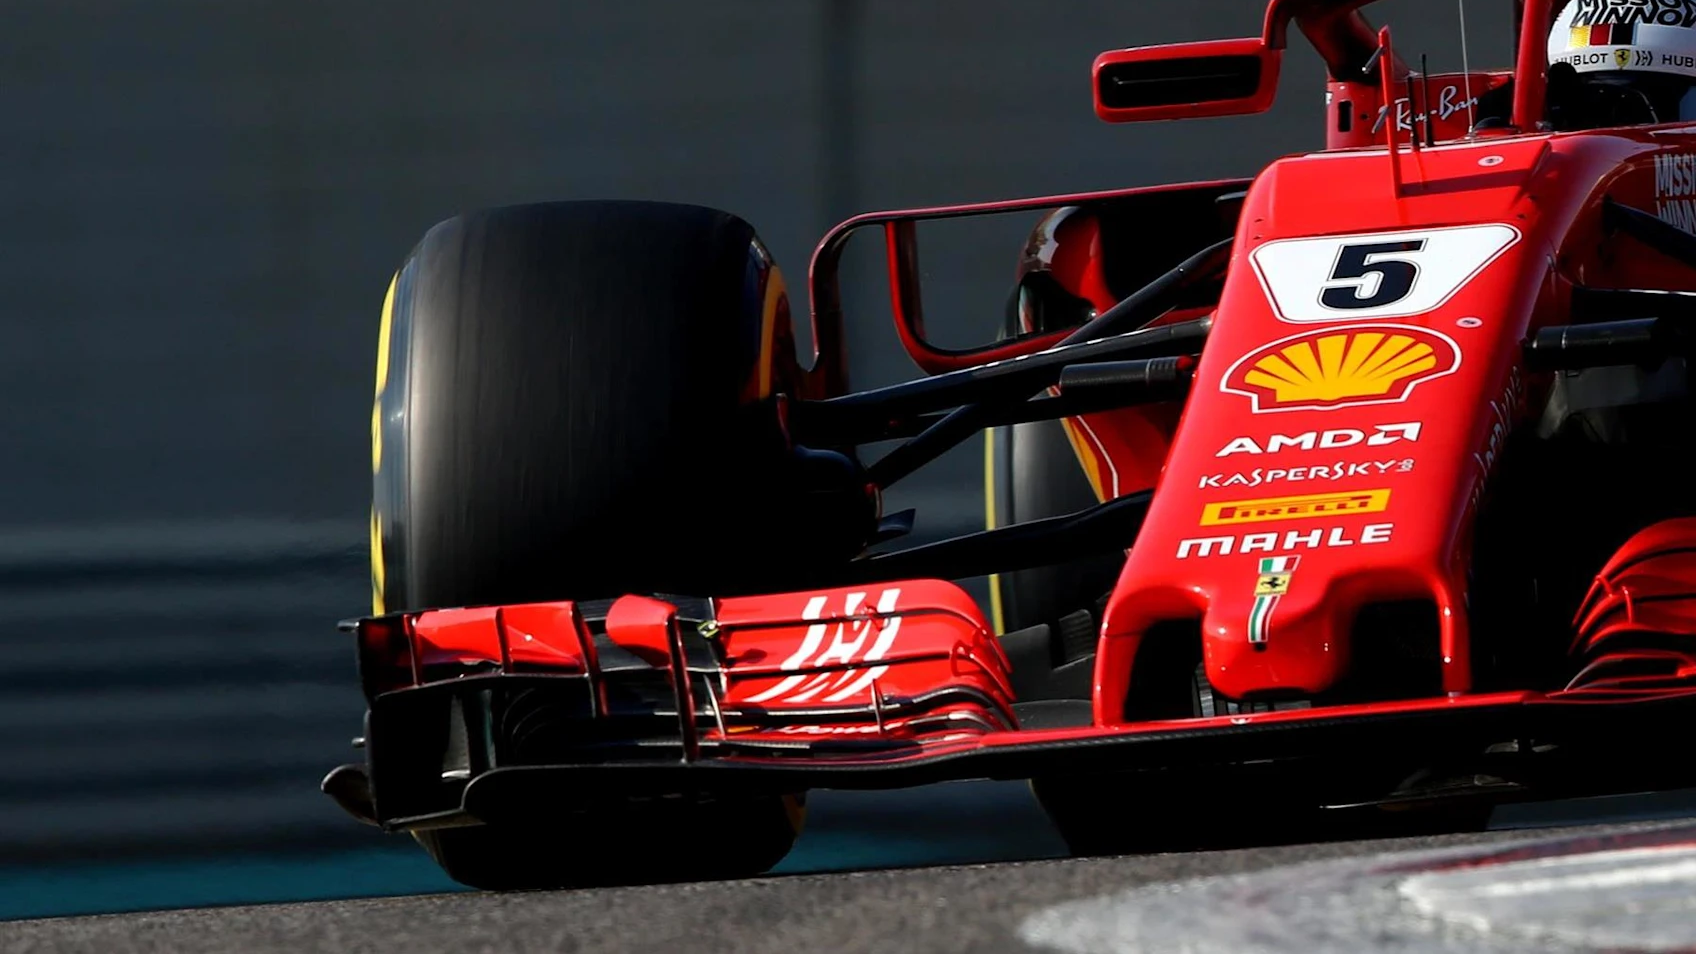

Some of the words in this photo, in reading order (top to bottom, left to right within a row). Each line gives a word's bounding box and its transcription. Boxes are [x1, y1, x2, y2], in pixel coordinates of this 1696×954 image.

[1554, 52, 1609, 66] UBLOT
[1318, 238, 1428, 310] 5
[1215, 427, 1366, 458] AMD
[1198, 459, 1396, 489] KASPERSKY
[1216, 494, 1374, 521] PIRELLI
[1175, 523, 1394, 558] MAHLE
